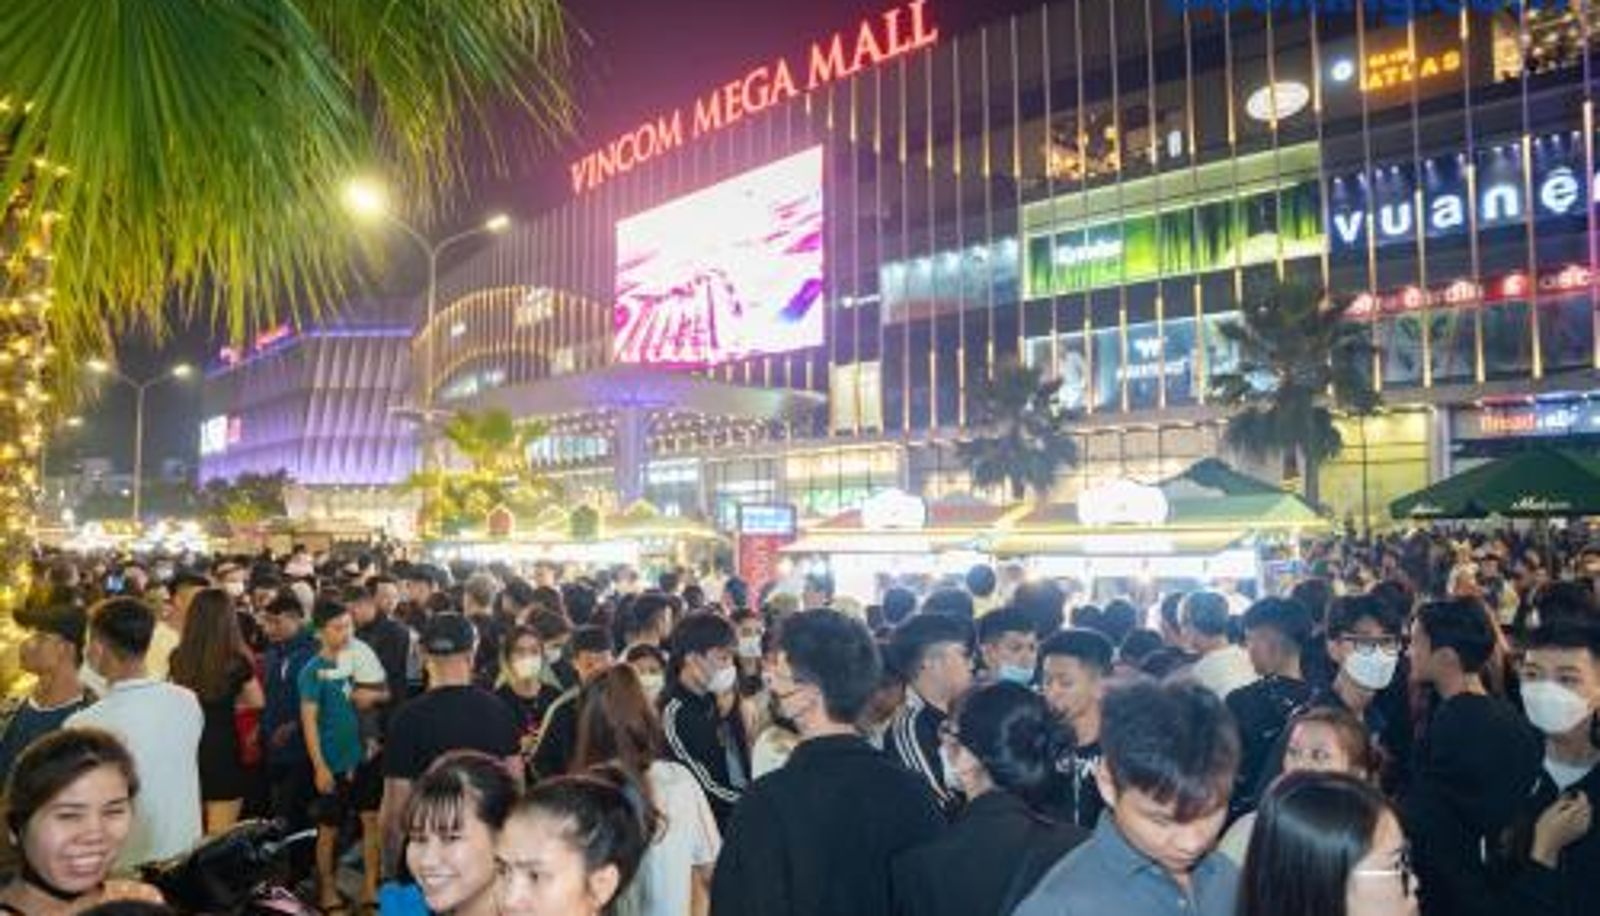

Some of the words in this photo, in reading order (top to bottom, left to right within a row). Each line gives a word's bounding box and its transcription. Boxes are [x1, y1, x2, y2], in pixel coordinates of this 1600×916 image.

[571, 109, 683, 195] VINCOM
[693, 57, 797, 138] MEGA
[806, 0, 938, 90] MALL
[1368, 51, 1460, 88] ATLAS
